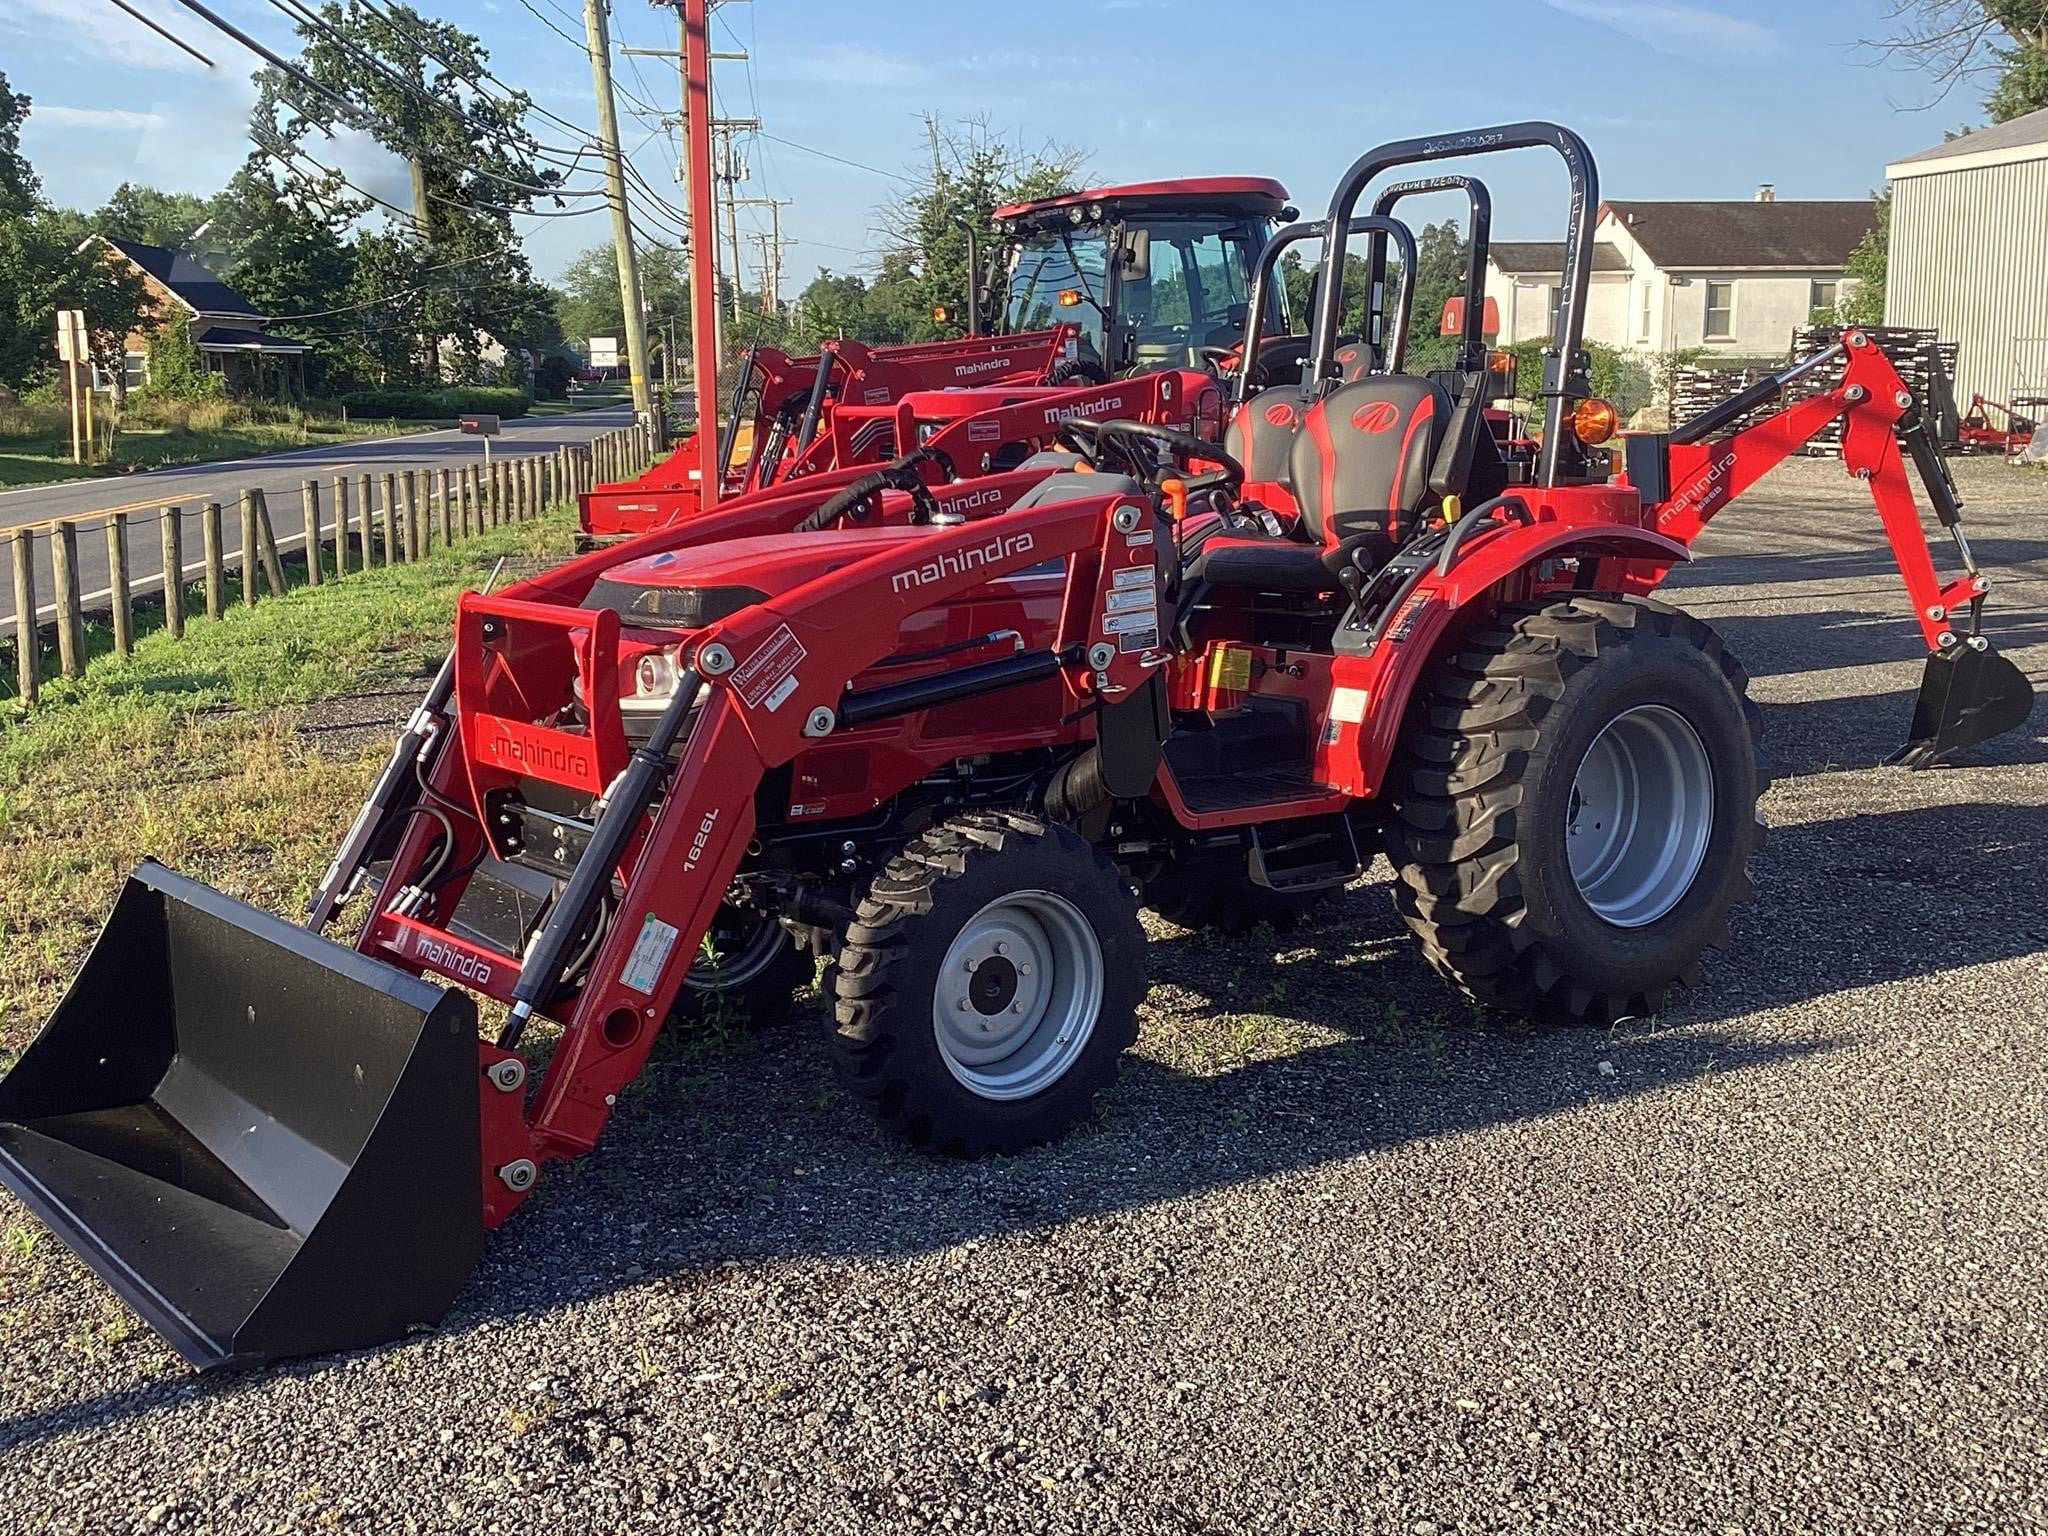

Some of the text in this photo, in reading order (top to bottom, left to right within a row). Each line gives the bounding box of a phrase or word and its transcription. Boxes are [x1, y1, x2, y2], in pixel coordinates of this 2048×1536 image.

[908, 488, 1002, 524] hindra
[1659, 452, 1738, 525] mahindra
[891, 531, 1034, 593] mahindra
[495, 735, 589, 778] mahindra
[683, 808, 720, 872] 1626L
[416, 939, 492, 985] mahindra
